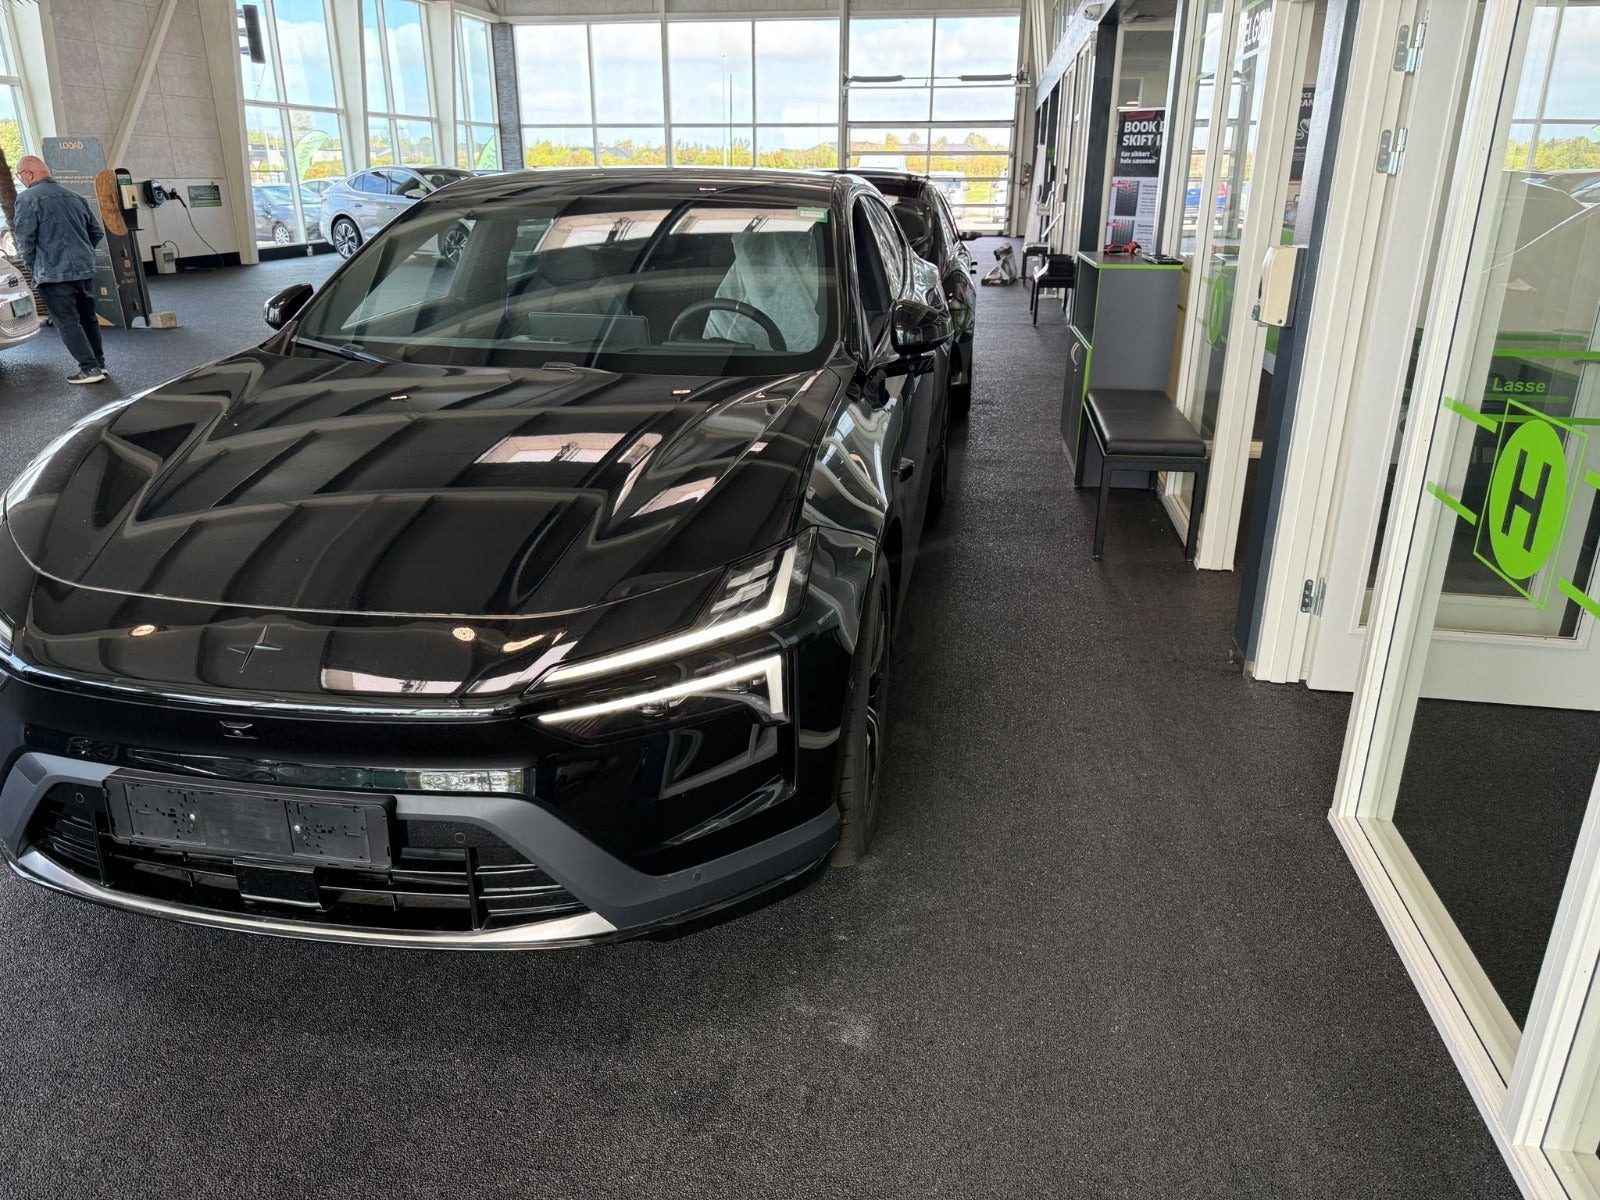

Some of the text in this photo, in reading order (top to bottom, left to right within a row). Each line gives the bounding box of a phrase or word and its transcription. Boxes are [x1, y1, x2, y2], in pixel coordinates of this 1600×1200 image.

[1124, 121, 1157, 133] BOOK
[1122, 134, 1154, 146] SKIFT
[1492, 377, 1546, 393] Lasse
